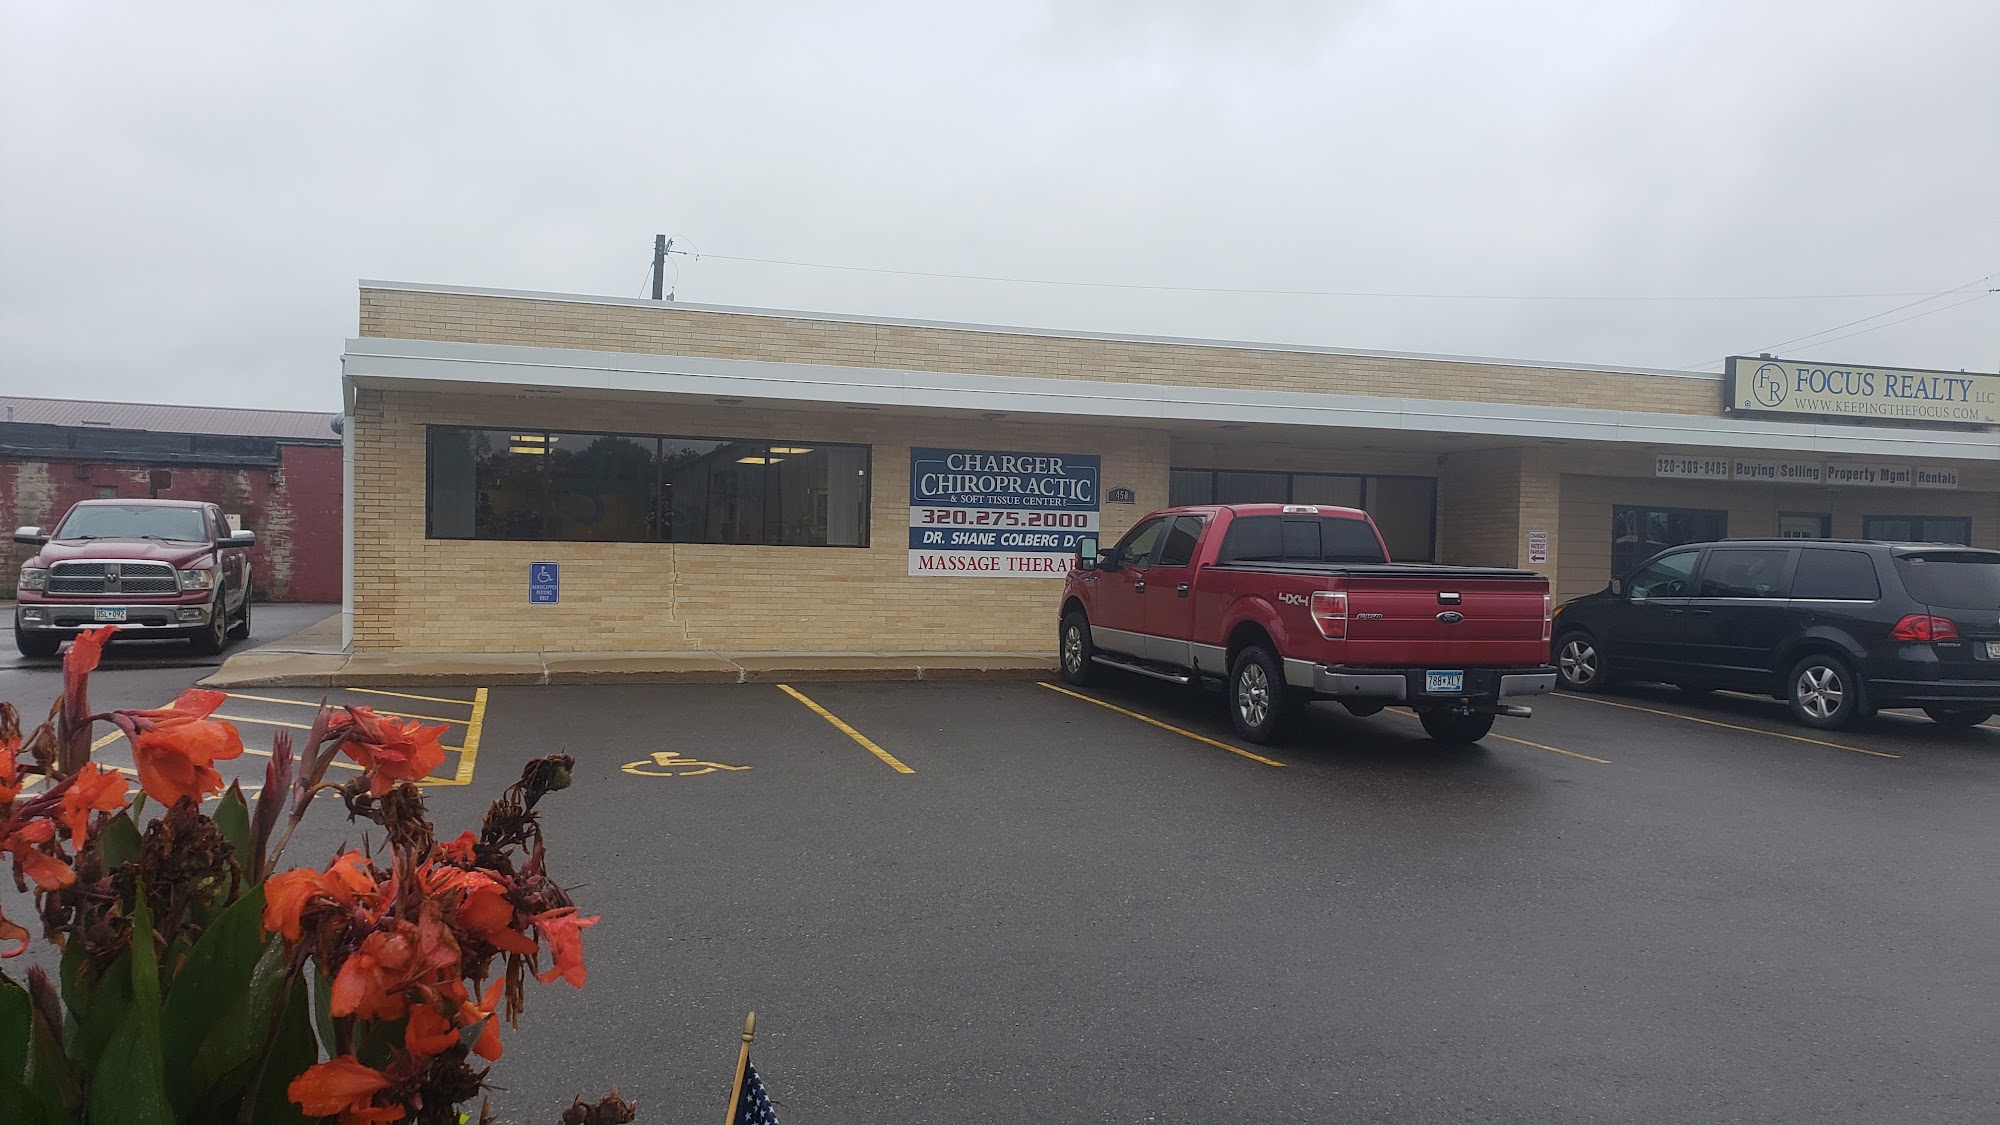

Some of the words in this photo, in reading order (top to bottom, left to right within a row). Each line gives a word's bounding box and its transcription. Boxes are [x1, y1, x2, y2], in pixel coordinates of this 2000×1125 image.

[1795, 368, 1875, 397] FOCUS
[1883, 374, 1974, 403] REALTY
[1976, 391, 1995, 404] LLC
[1795, 398, 1979, 420] WWW.KEEPINGTHEFOCUSCOM
[946, 453, 1067, 476] CHARGER
[1657, 459, 1728, 476] 320-309-8485
[1827, 466, 1876, 483] Property
[1880, 468, 1910, 484] Mgmt
[1918, 471, 1957, 486] Rentals
[920, 473, 1091, 502] CHIROPRACTIC
[1115, 490, 1129, 501] 450
[950, 494, 958, 503] &
[960, 494, 985, 504] SOFT
[986, 495, 1021, 505] TISSUE
[921, 509, 1088, 528] 320.275.2000
[922, 531, 946, 544] DR.
[950, 531, 997, 546] SHANE
[1000, 533, 1060, 548] COLBERG
[918, 555, 1001, 571] MASSAGE
